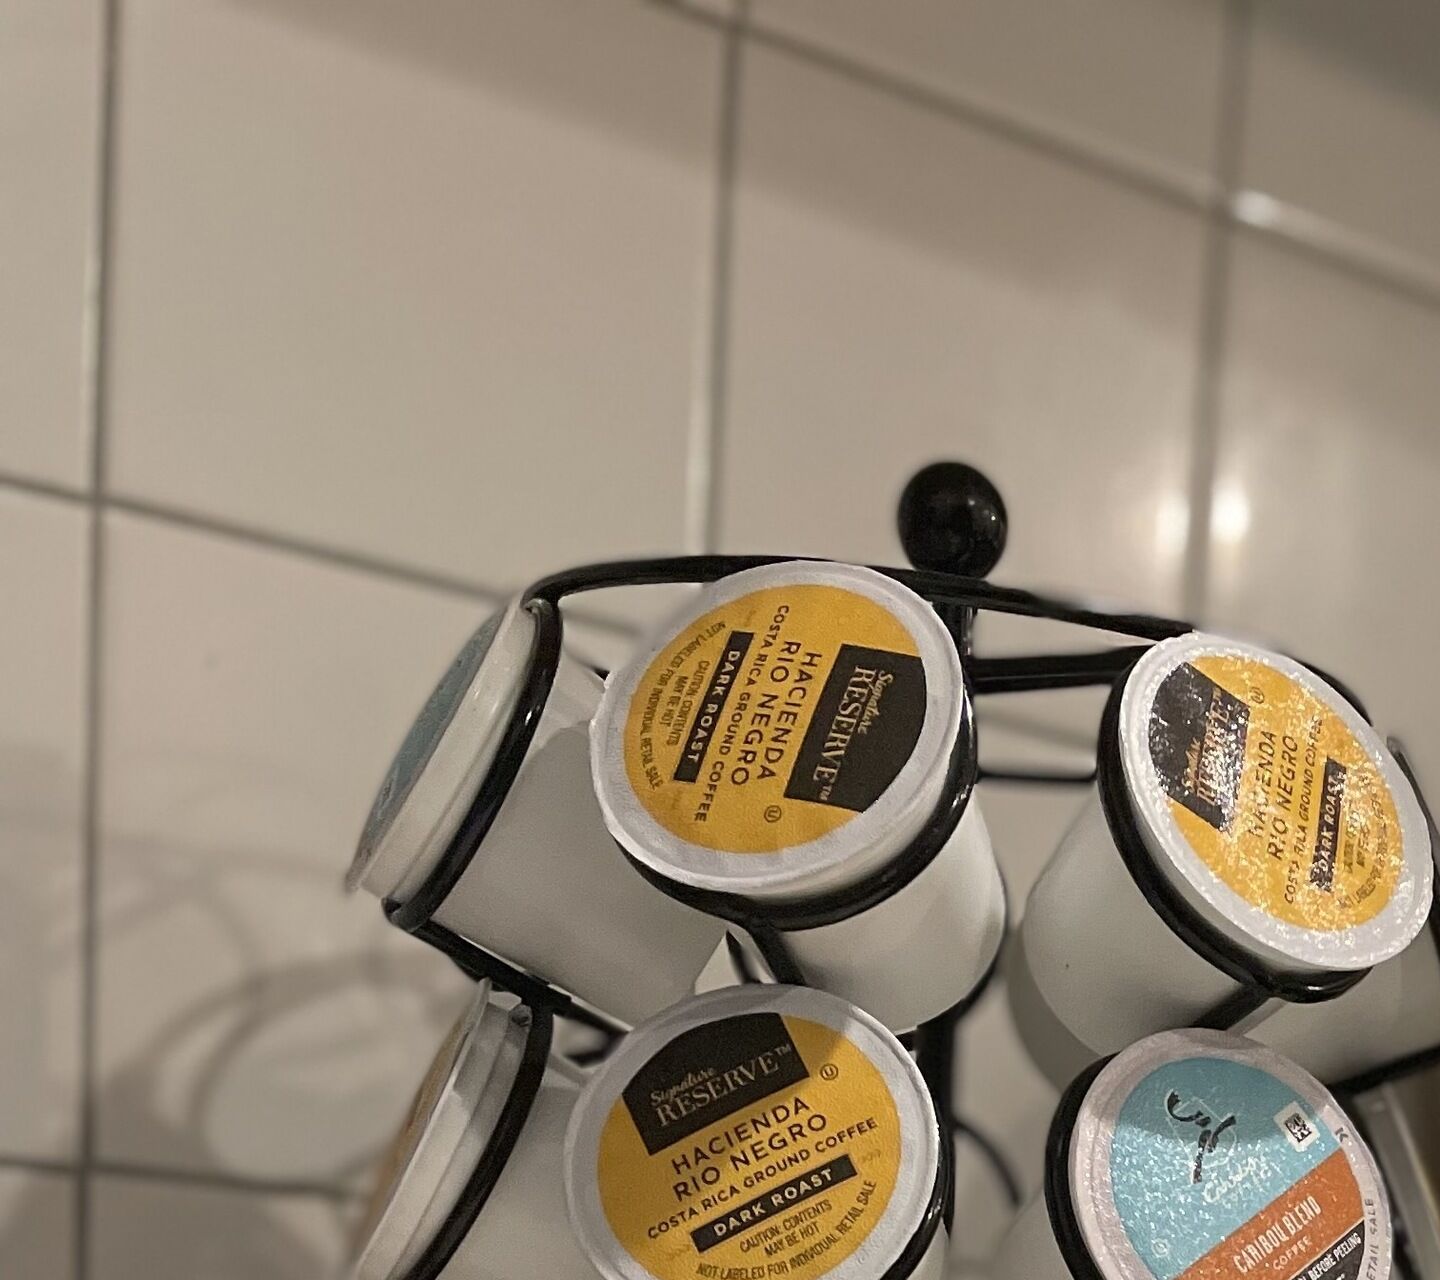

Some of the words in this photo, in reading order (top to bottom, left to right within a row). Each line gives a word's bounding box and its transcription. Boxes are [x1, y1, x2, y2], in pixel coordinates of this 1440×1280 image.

[761, 605, 789, 649] COSTA
[711, 650, 741, 697] DARK
[745, 653, 769, 686] RICA
[770, 641, 801, 683] RIO
[684, 703, 719, 761] ROAST
[720, 693, 750, 755] GROUND
[731, 693, 778, 785] NEGRO
[757, 652, 821, 780] HACIENDA
[694, 761, 725, 822] COFFEE
[1278, 736, 1298, 811] NEGRO
[1299, 765, 1314, 824] GROUND
[1319, 829, 1334, 871] DARK
[650, 1068, 715, 1107] Signature
[670, 1097, 810, 1174] HACIENDA
[672, 1167, 720, 1202] RIO
[730, 1113, 828, 1172] NEGRO
[648, 1208, 698, 1239] COSTA
[702, 1186, 740, 1212] RICA
[744, 1149, 810, 1189] GROUND
[815, 1118, 878, 1153] COFFEE
[713, 1206, 766, 1236] DARK
[771, 1168, 833, 1207] ROAST
[696, 1263, 719, 1277] NOT
[720, 1263, 765, 1280] LABELED
[767, 1258, 789, 1276] FOR
[837, 1208, 861, 1236] RETAIL
[858, 1180, 877, 1208] SALE
[1234, 1225, 1288, 1274] CARIBOU
[1285, 1196, 1321, 1237] BLEND
[1332, 1232, 1361, 1265] PEELING
[1364, 1199, 1379, 1238] SALE
